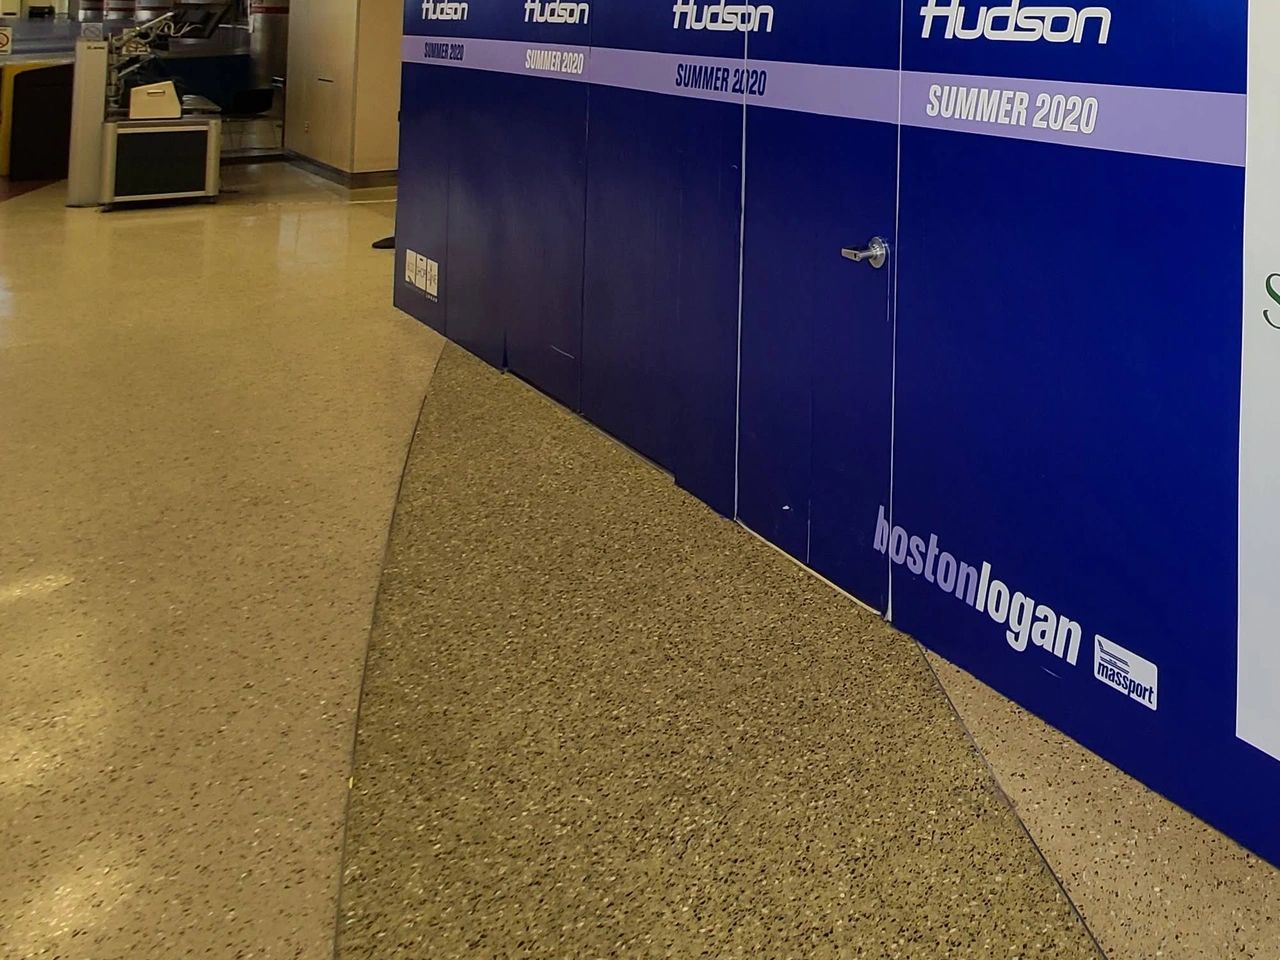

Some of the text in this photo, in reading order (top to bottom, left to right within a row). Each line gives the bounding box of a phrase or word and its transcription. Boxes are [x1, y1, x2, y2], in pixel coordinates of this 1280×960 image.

[424, 42, 464, 61] SUMMER 2020
[525, 49, 585, 75] SUMMER 2020
[675, 63, 768, 97] SUMMER 2020
[926, 84, 1099, 135] SUMMER 2020
[1097, 662, 1154, 705] massport
